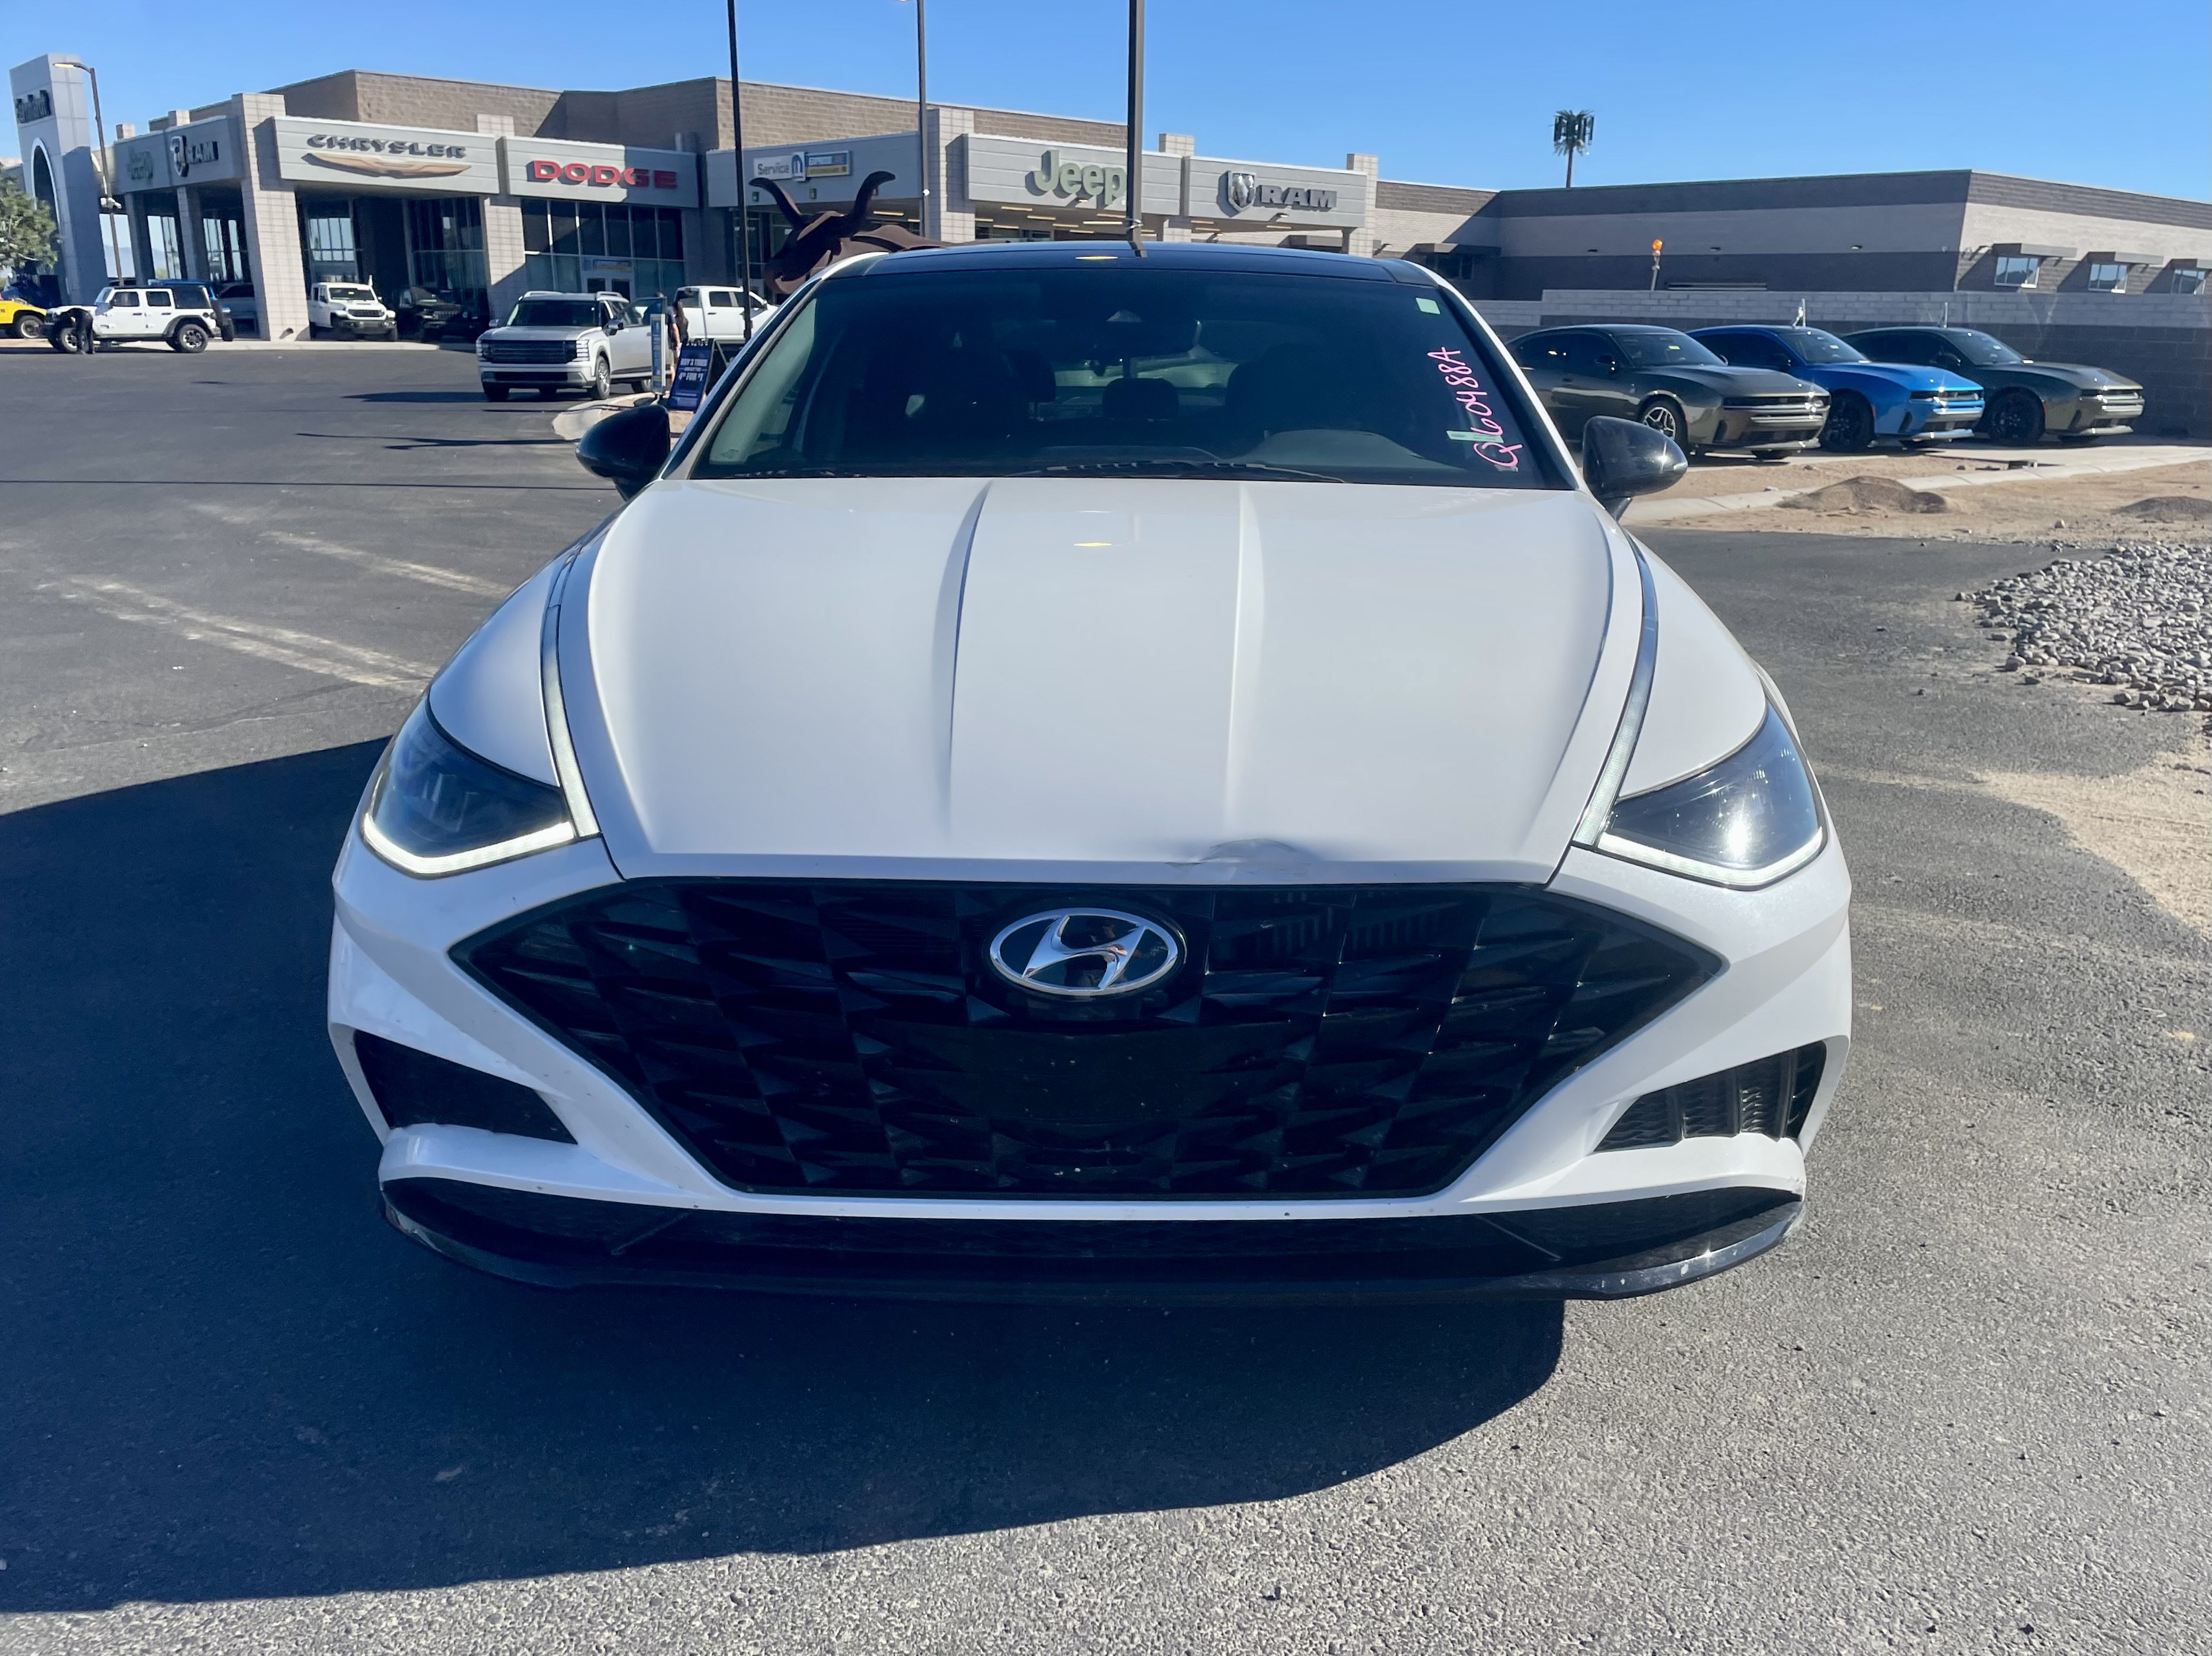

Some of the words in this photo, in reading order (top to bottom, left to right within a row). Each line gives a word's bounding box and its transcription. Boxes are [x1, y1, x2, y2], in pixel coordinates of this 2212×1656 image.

[307, 134, 467, 159] CHRYSLER
[533, 160, 678, 189] DODGE
[758, 162, 790, 175] Service
[1034, 150, 1127, 205] Jeep
[1260, 185, 1338, 209] RAM
